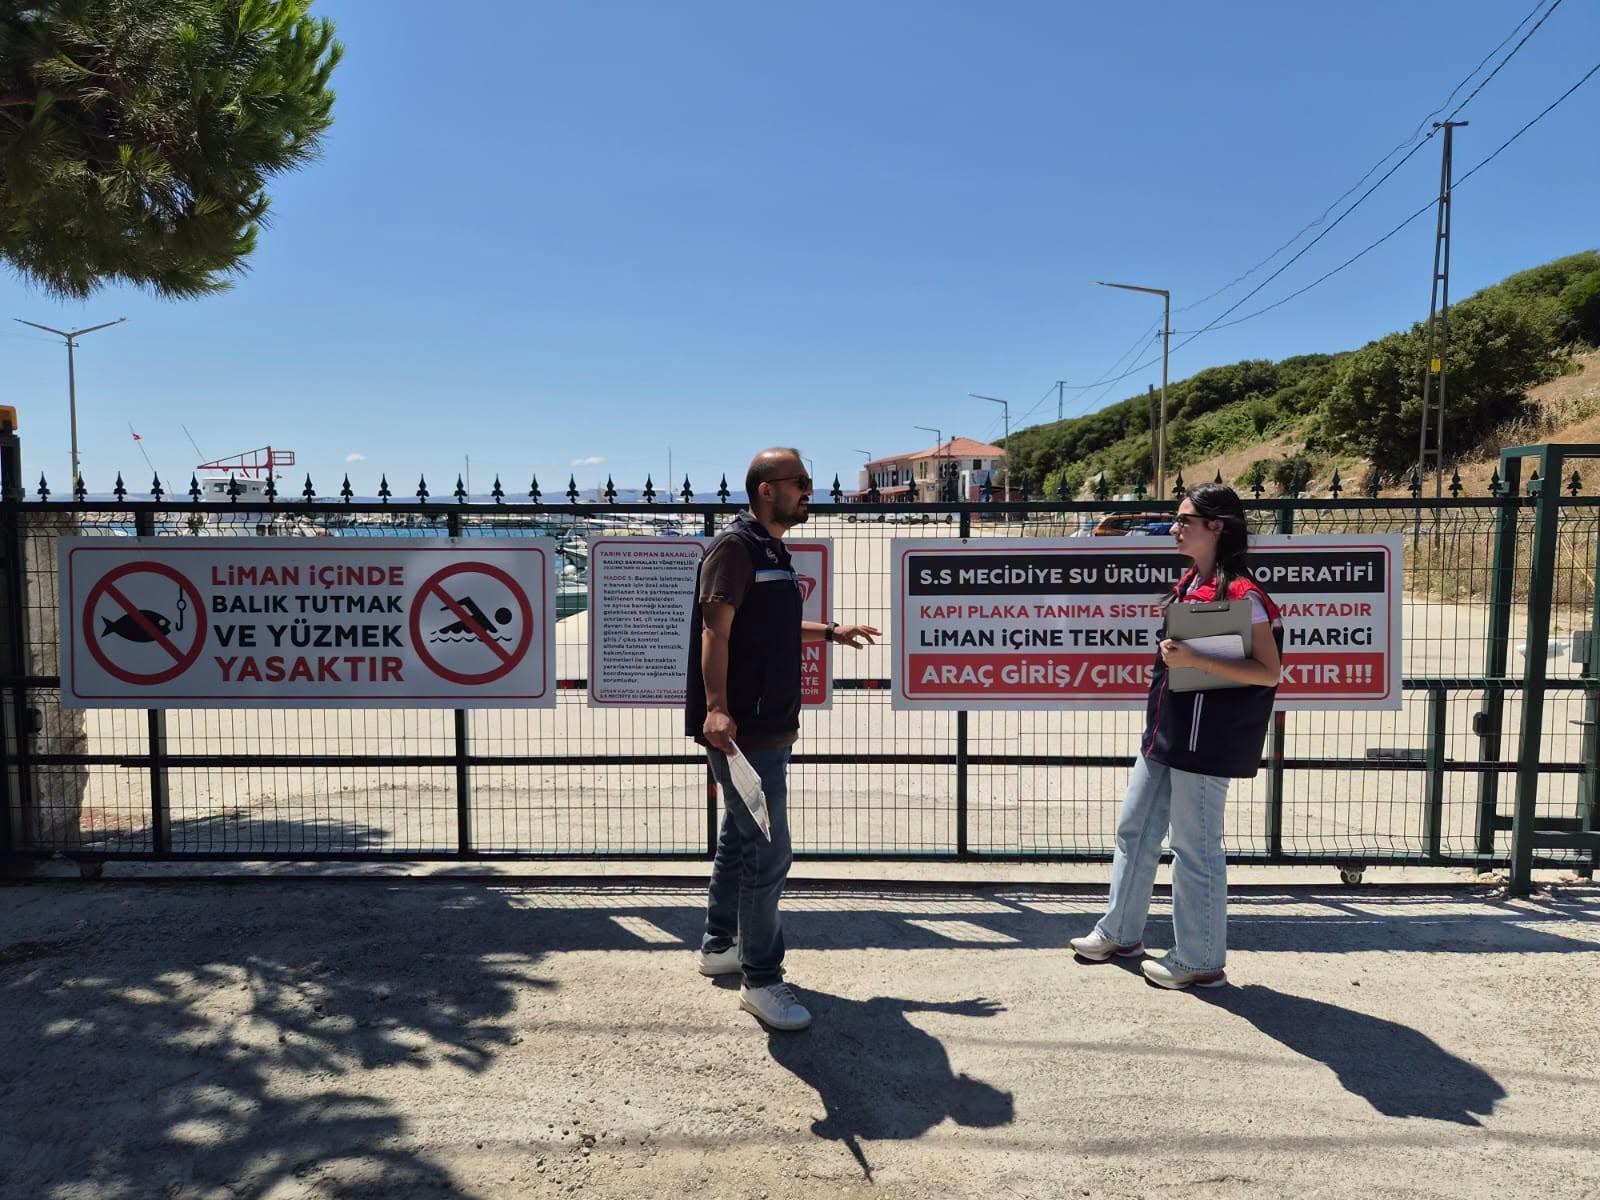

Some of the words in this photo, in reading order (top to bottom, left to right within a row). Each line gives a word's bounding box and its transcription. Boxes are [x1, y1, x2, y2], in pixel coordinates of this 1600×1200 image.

[920, 569, 952, 585] S.S
[959, 564, 1063, 585] MECİDİYE
[1069, 568, 1098, 584] SU
[1104, 564, 1187, 584] ÜRÜNL
[1247, 561, 1373, 582] OPERATİFİ
[212, 595, 289, 613] BALIK
[295, 595, 404, 613] TUTMAK
[920, 606, 963, 619] KAPI
[968, 605, 1029, 619] PLAKA
[1033, 604, 1105, 618] TANIMA
[214, 625, 258, 648] VE
[271, 618, 404, 648] YÜZMEK
[1069, 629, 1148, 646] TEKNE
[215, 656, 405, 683] YASAKTIR
[921, 664, 994, 688] ARAÇ
[1279, 664, 1340, 684] KTIR
